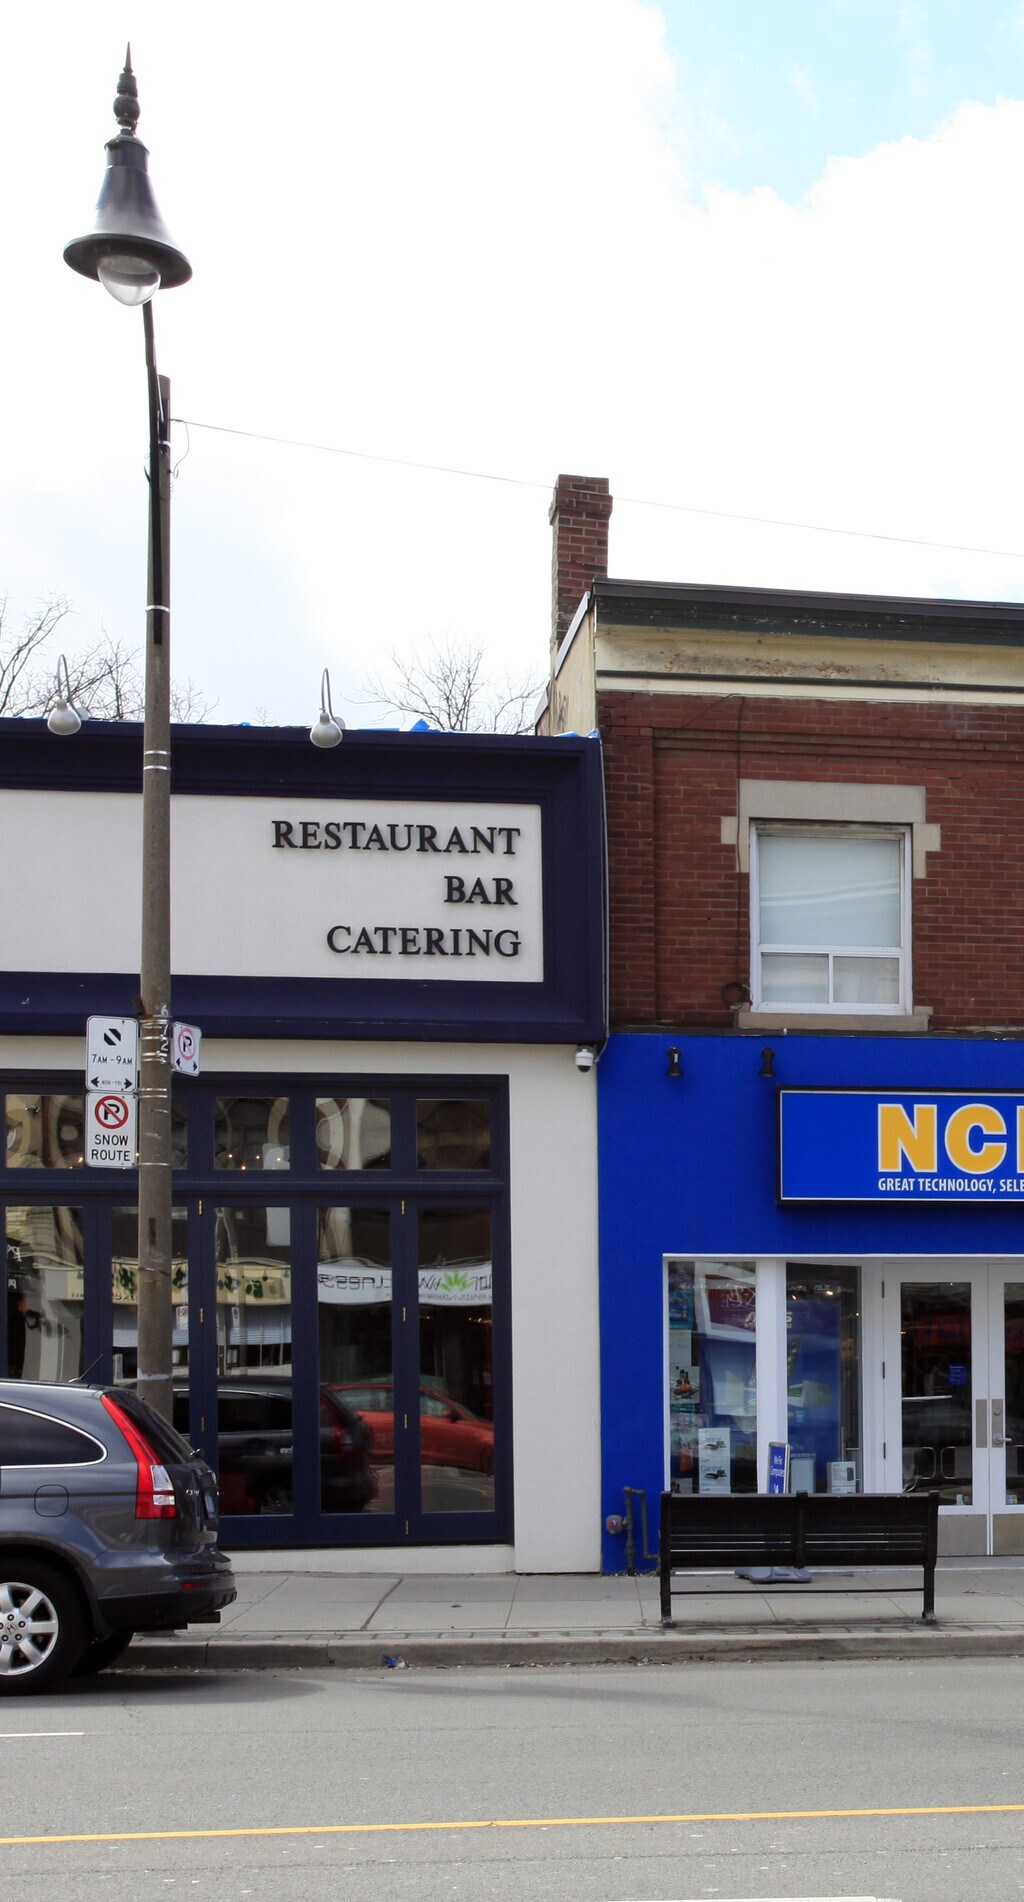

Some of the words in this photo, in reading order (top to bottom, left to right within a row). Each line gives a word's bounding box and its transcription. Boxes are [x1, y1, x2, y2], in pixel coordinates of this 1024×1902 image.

[271, 820, 521, 855] RESTAURANT
[443, 875, 518, 905] BAR
[326, 925, 522, 957] CATERING
[94, 1134, 129, 1146] SNOW
[91, 1149, 131, 1161] ROUTE
[878, 1178, 915, 1191] GREAT
[918, 1178, 997, 1194] TECHNOLOGY,
